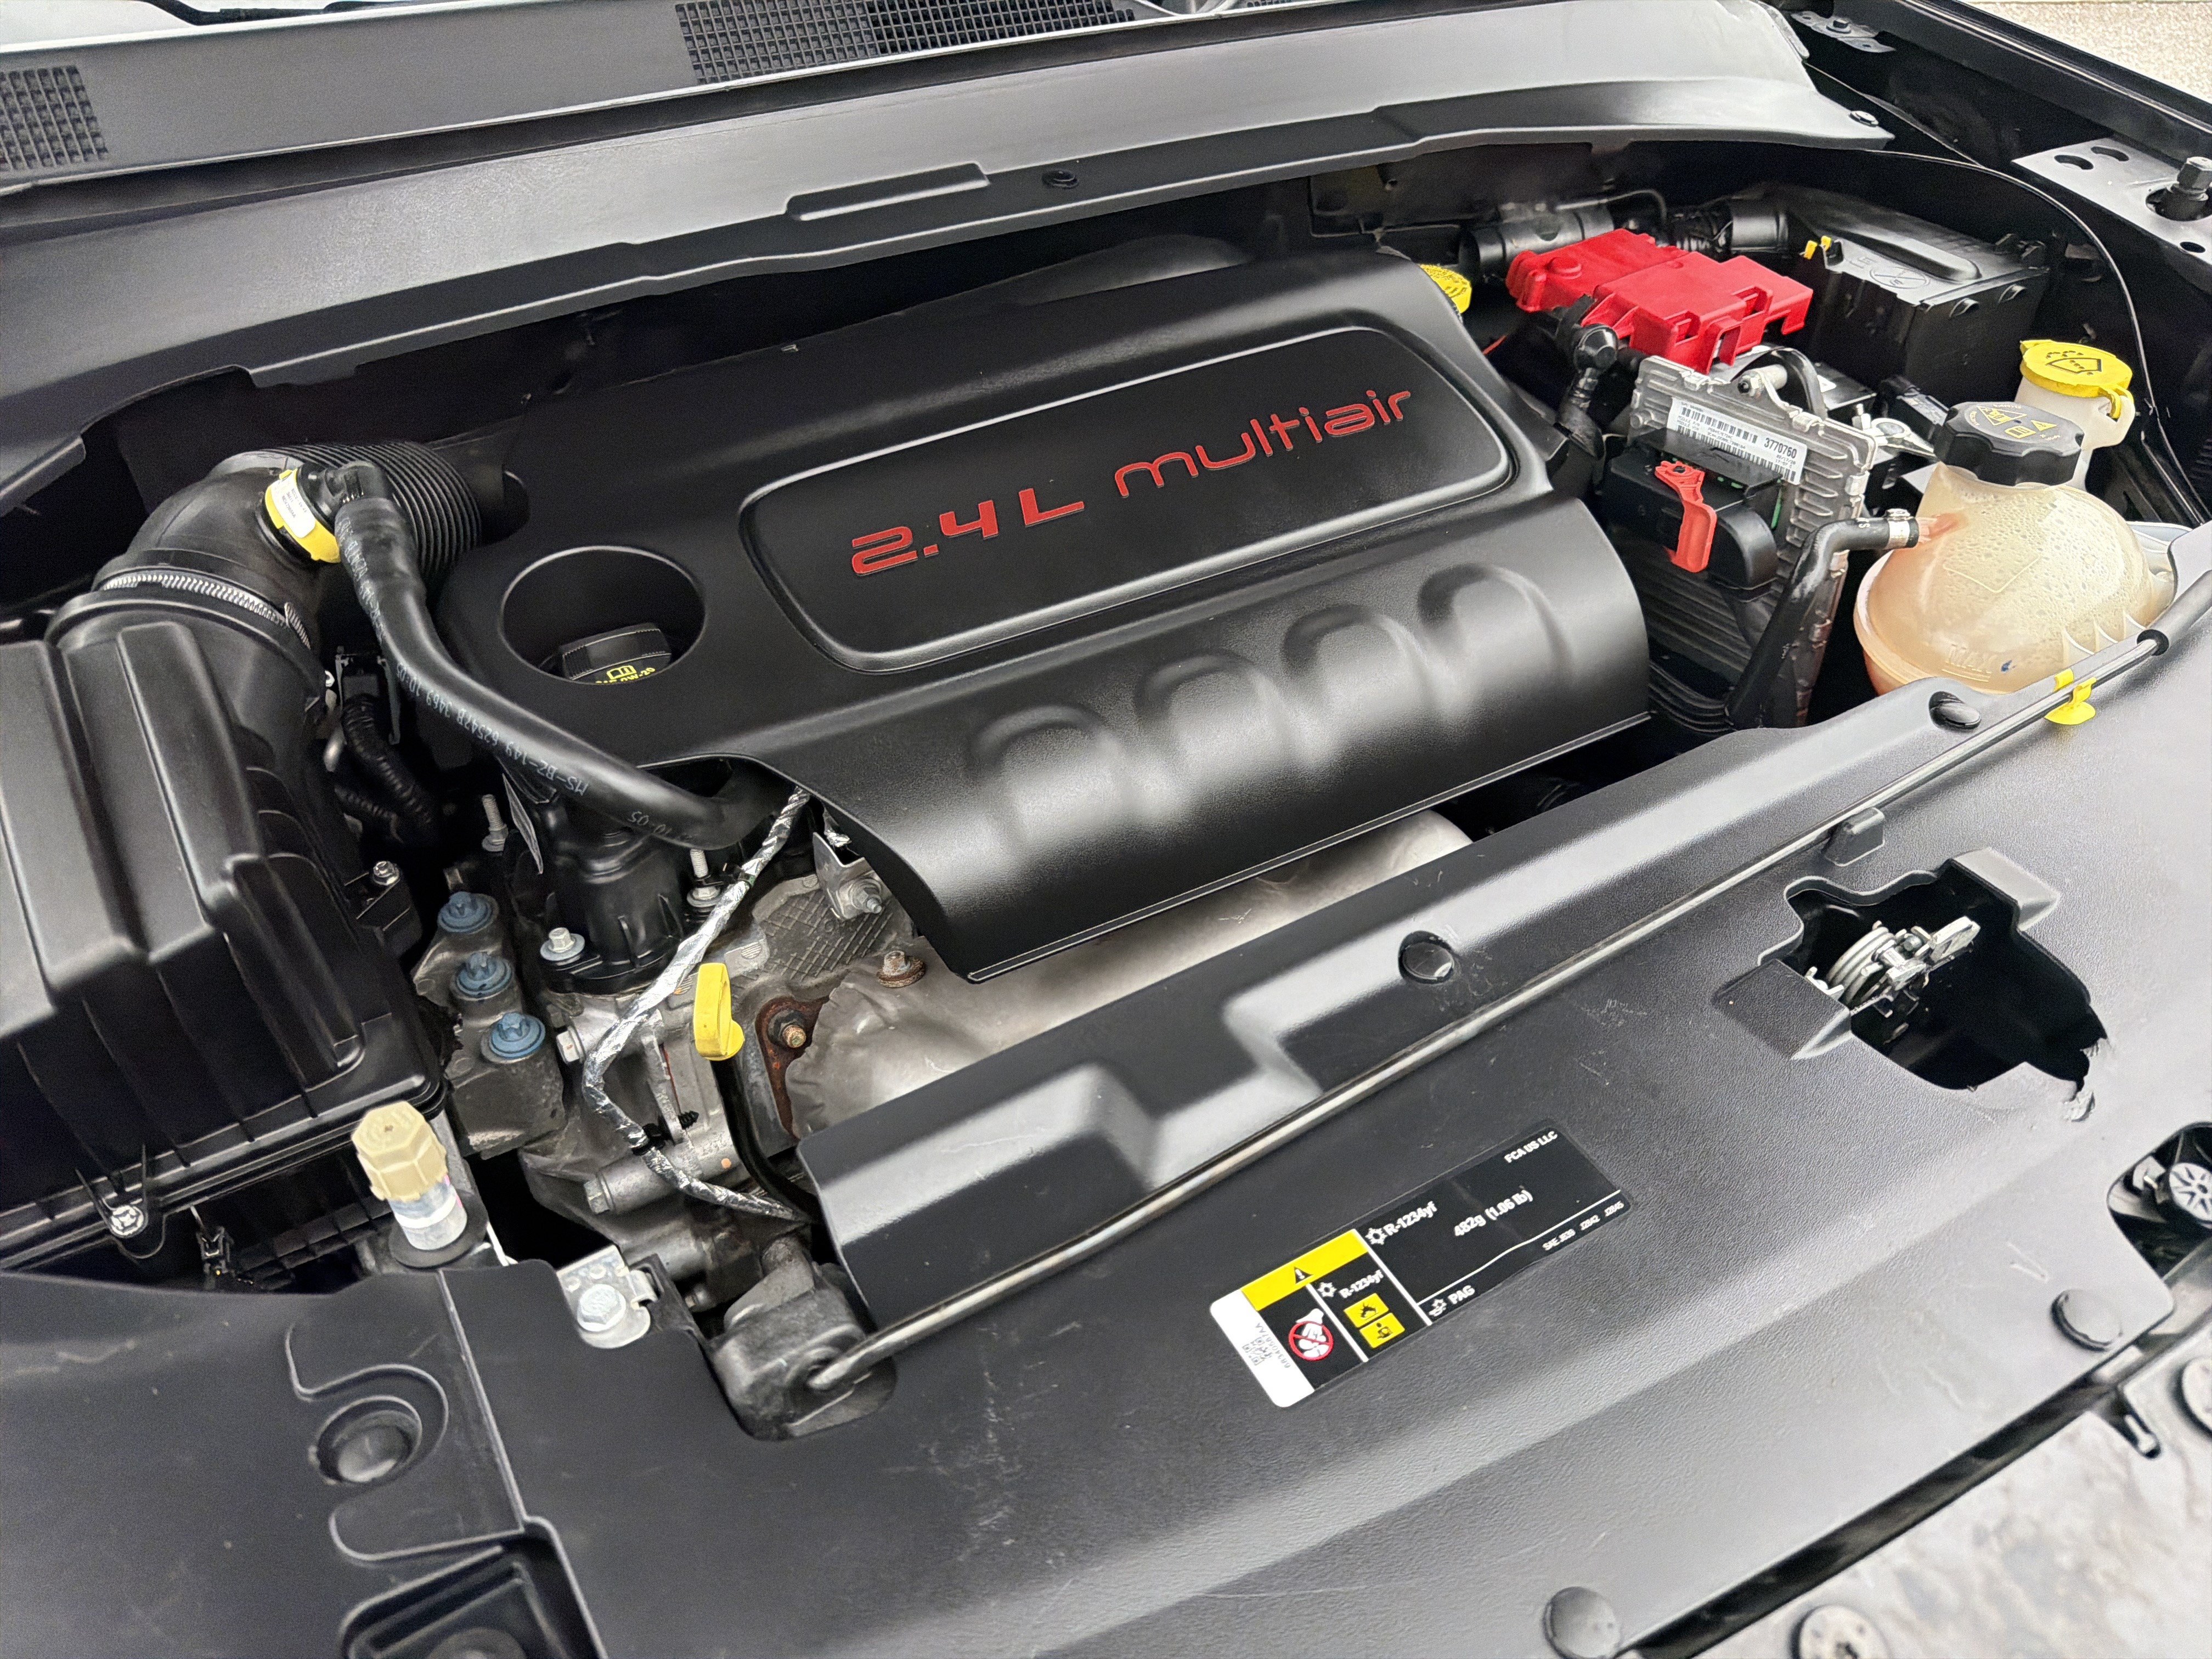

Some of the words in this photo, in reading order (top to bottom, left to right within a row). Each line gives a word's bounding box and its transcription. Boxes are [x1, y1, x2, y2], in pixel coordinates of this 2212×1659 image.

[1763, 437, 1797, 459] 3770760
[851, 498, 998, 577] 2.4
[1018, 487, 1085, 527] L
[1114, 390, 1411, 498] multiair
[504, 741, 589, 796] MS-BZ-149
[1504, 1148, 1526, 1163] FCA
[1523, 1141, 1539, 1152] US
[1537, 1131, 1558, 1146] LLC
[1383, 1200, 1437, 1235] R-1234yf
[1454, 1214, 1487, 1236] 482g
[1485, 1199, 1516, 1221] (1.06
[1511, 1189, 1533, 1205] lb)
[1338, 1269, 1384, 1298] R-1234yf
[1448, 1285, 1475, 1305] PAG
